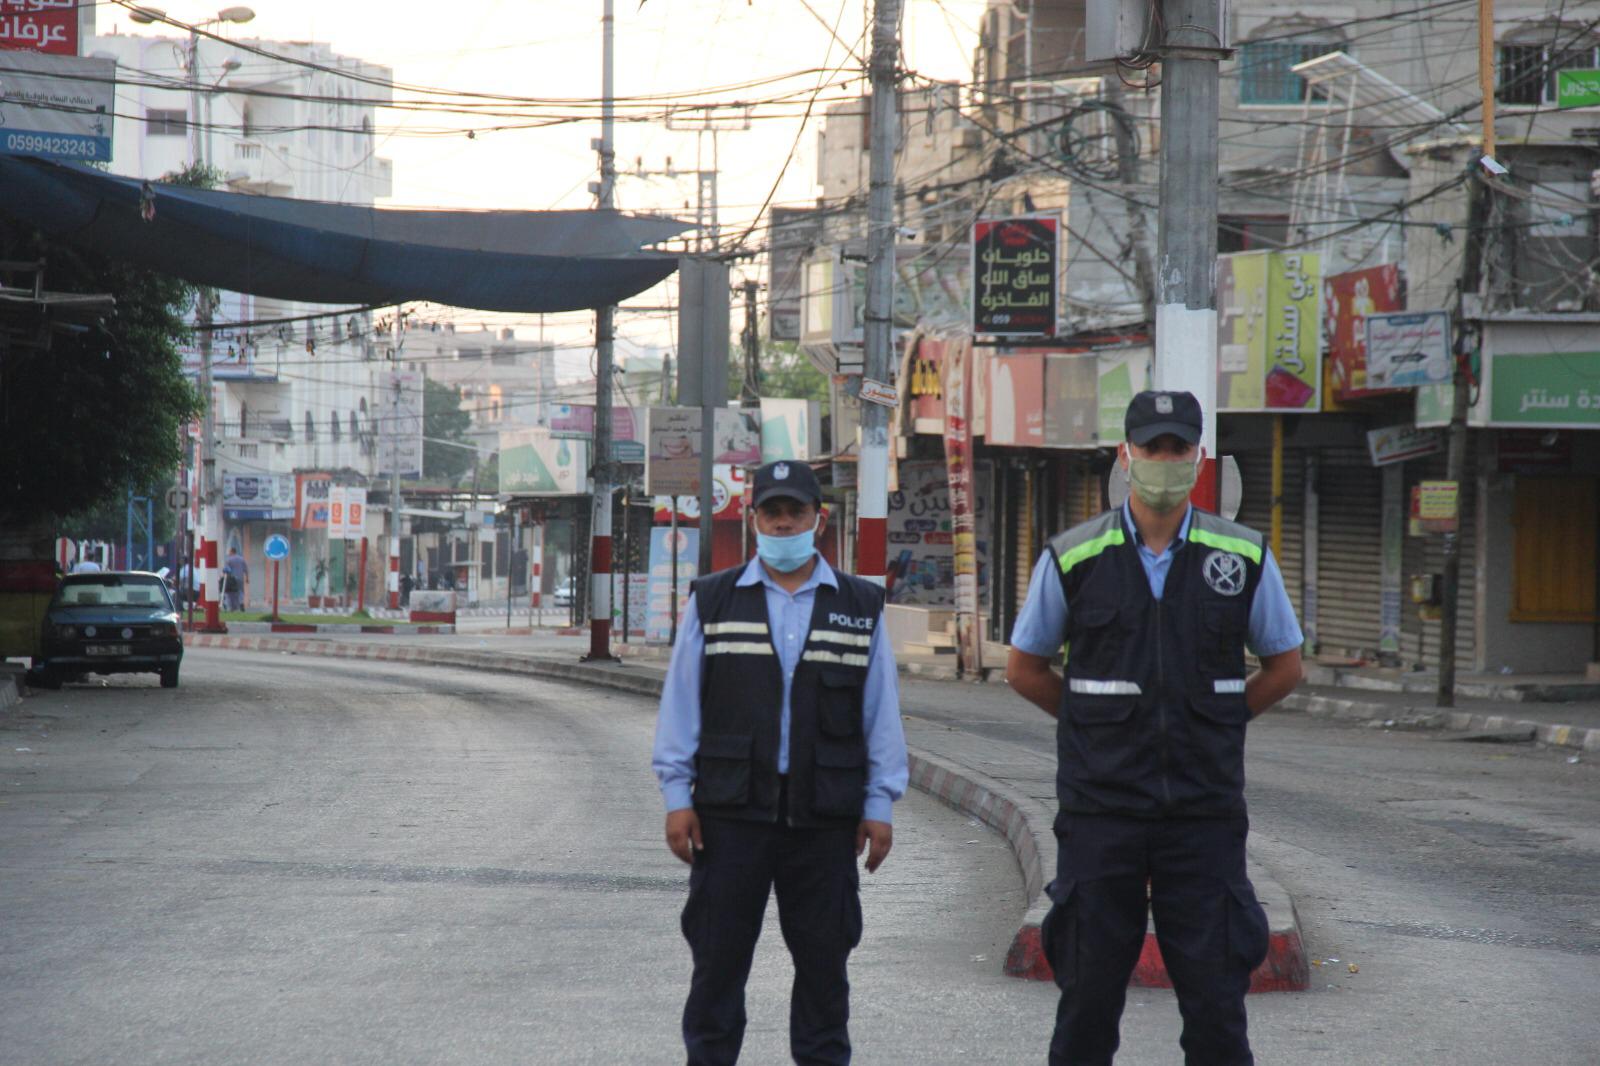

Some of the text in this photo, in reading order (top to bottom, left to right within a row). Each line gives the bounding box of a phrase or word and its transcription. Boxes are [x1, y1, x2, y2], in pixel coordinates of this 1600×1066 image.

[7, 134, 96, 156] 0599423243
[982, 248, 1050, 267] حلويات
[981, 291, 1050, 310] الفاخرة
[1275, 304, 1305, 374] سنتر
[1519, 388, 1569, 413] سنتر
[828, 612, 874, 630] POLICE
